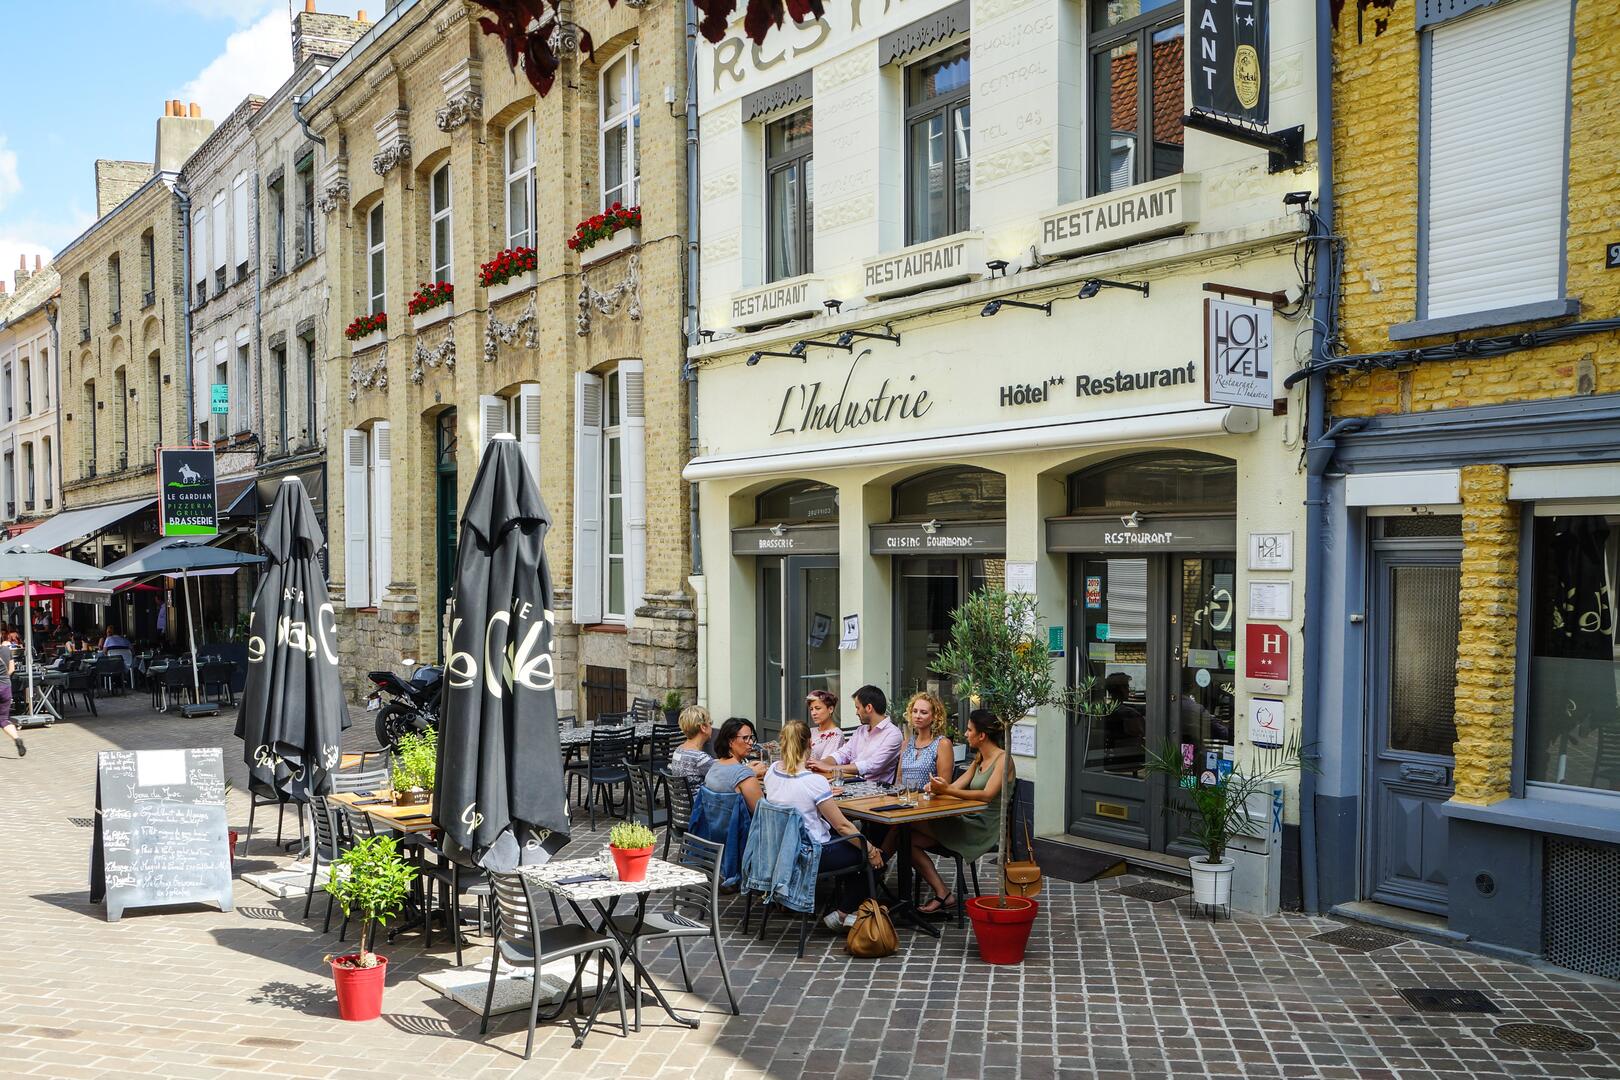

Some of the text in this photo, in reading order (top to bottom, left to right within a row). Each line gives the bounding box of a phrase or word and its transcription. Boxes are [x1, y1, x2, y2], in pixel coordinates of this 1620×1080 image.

[1043, 188, 1178, 244] RESTAURANT
[865, 243, 965, 287] RESTAURANT
[732, 282, 809, 317] RESTAURANT
[769, 349, 934, 436] L'Industrie
[1000, 360, 1196, 407] Hôtel Restaurant
[169, 516, 214, 526] BRASSERIE
[758, 539, 794, 548] BRASSERIE
[887, 536, 973, 547] CUISINE GOURMANDE
[1104, 532, 1173, 544] RESTAURANT
[1262, 633, 1281, 654] H
